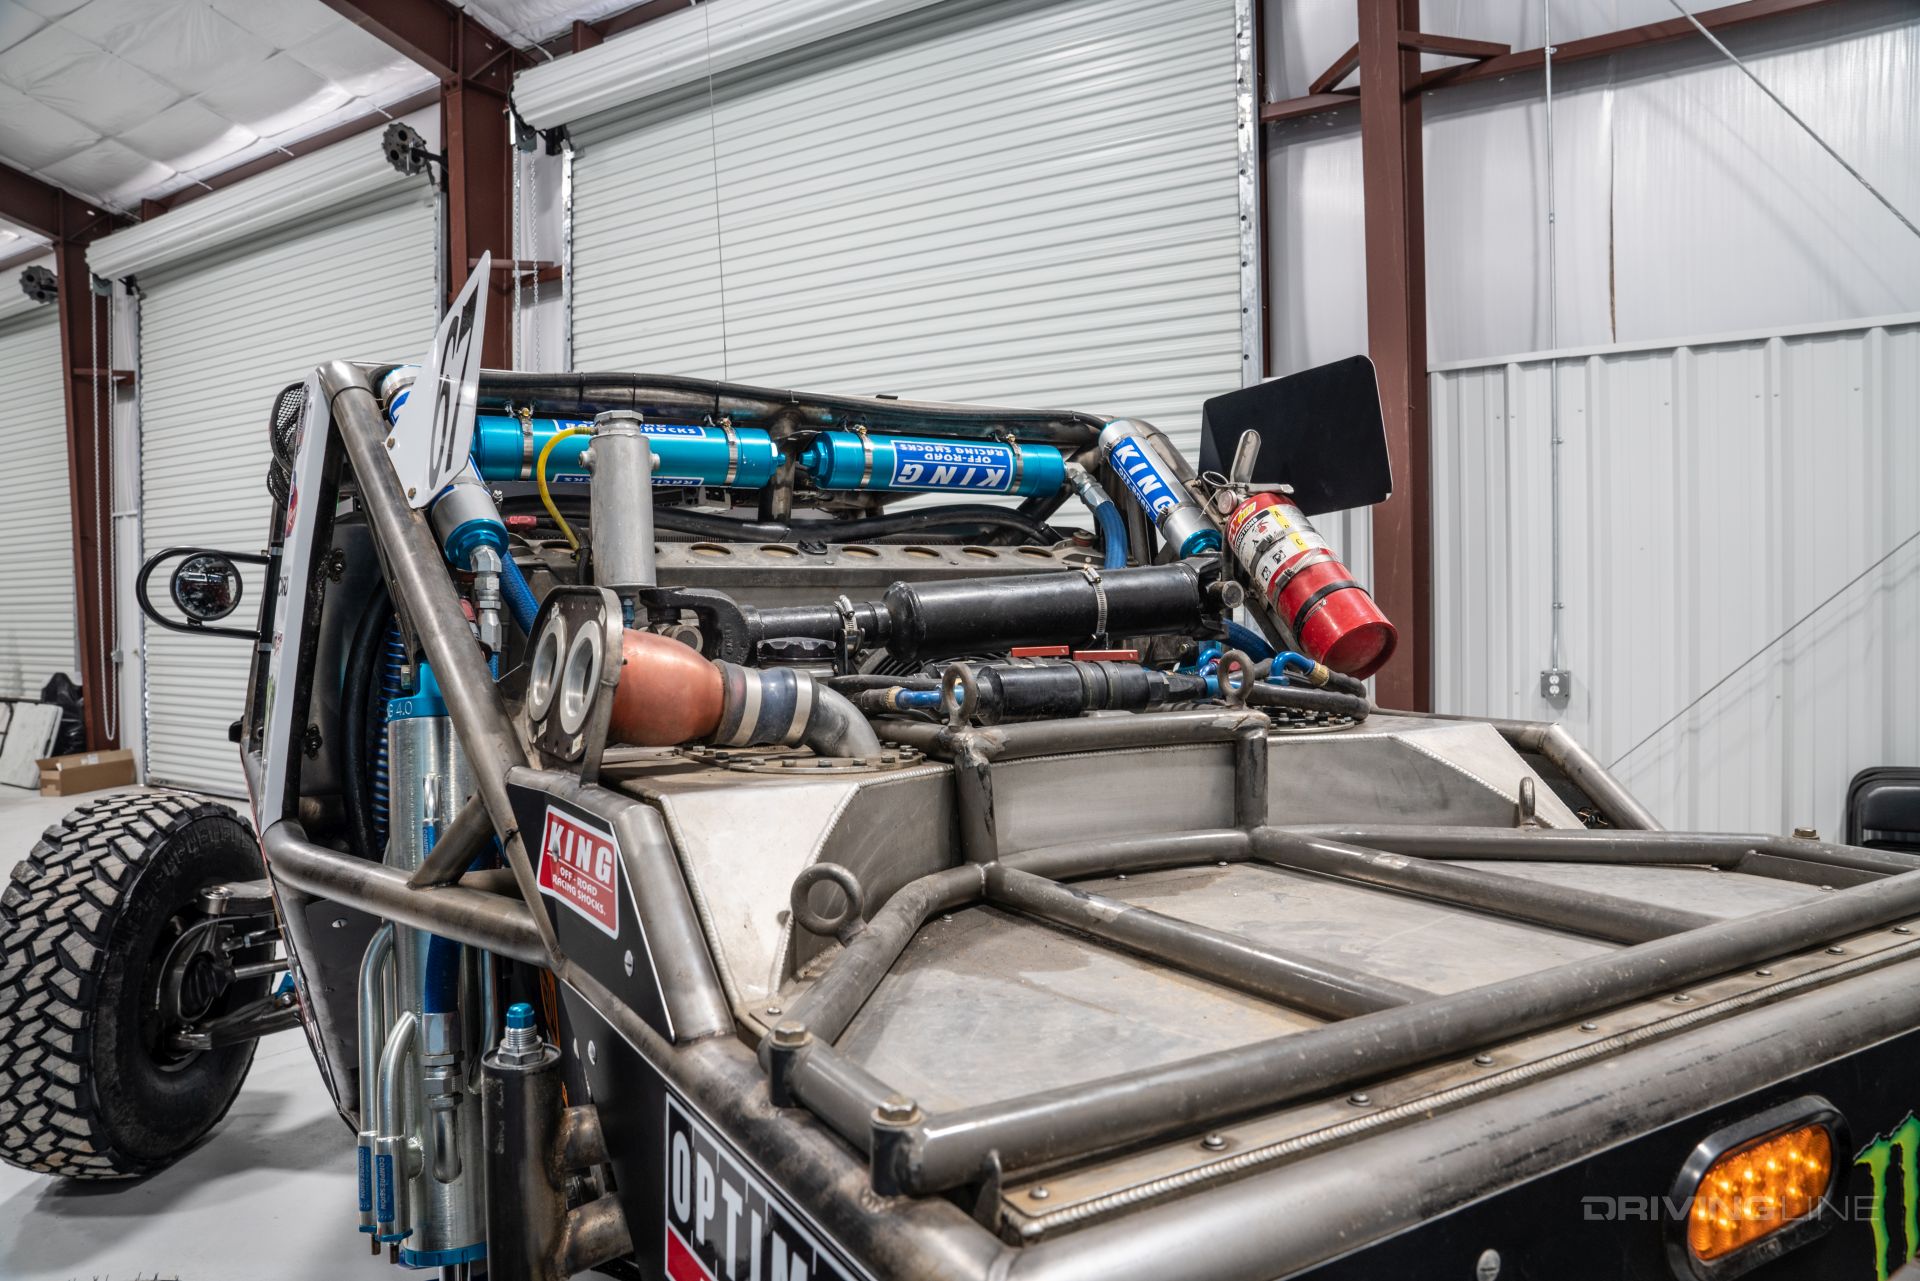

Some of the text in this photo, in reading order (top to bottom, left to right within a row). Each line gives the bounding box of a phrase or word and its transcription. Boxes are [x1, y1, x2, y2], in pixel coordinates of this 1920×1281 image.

[899, 443, 1005, 457] RACING SHOCKS
[924, 453, 992, 465] OFF-ROAD
[897, 463, 1006, 488] KING
[395, 701, 413, 716] 4.0
[547, 820, 614, 886] KING
[552, 873, 577, 898] RACING
[378, 1156, 386, 1210] COMPRESSION
